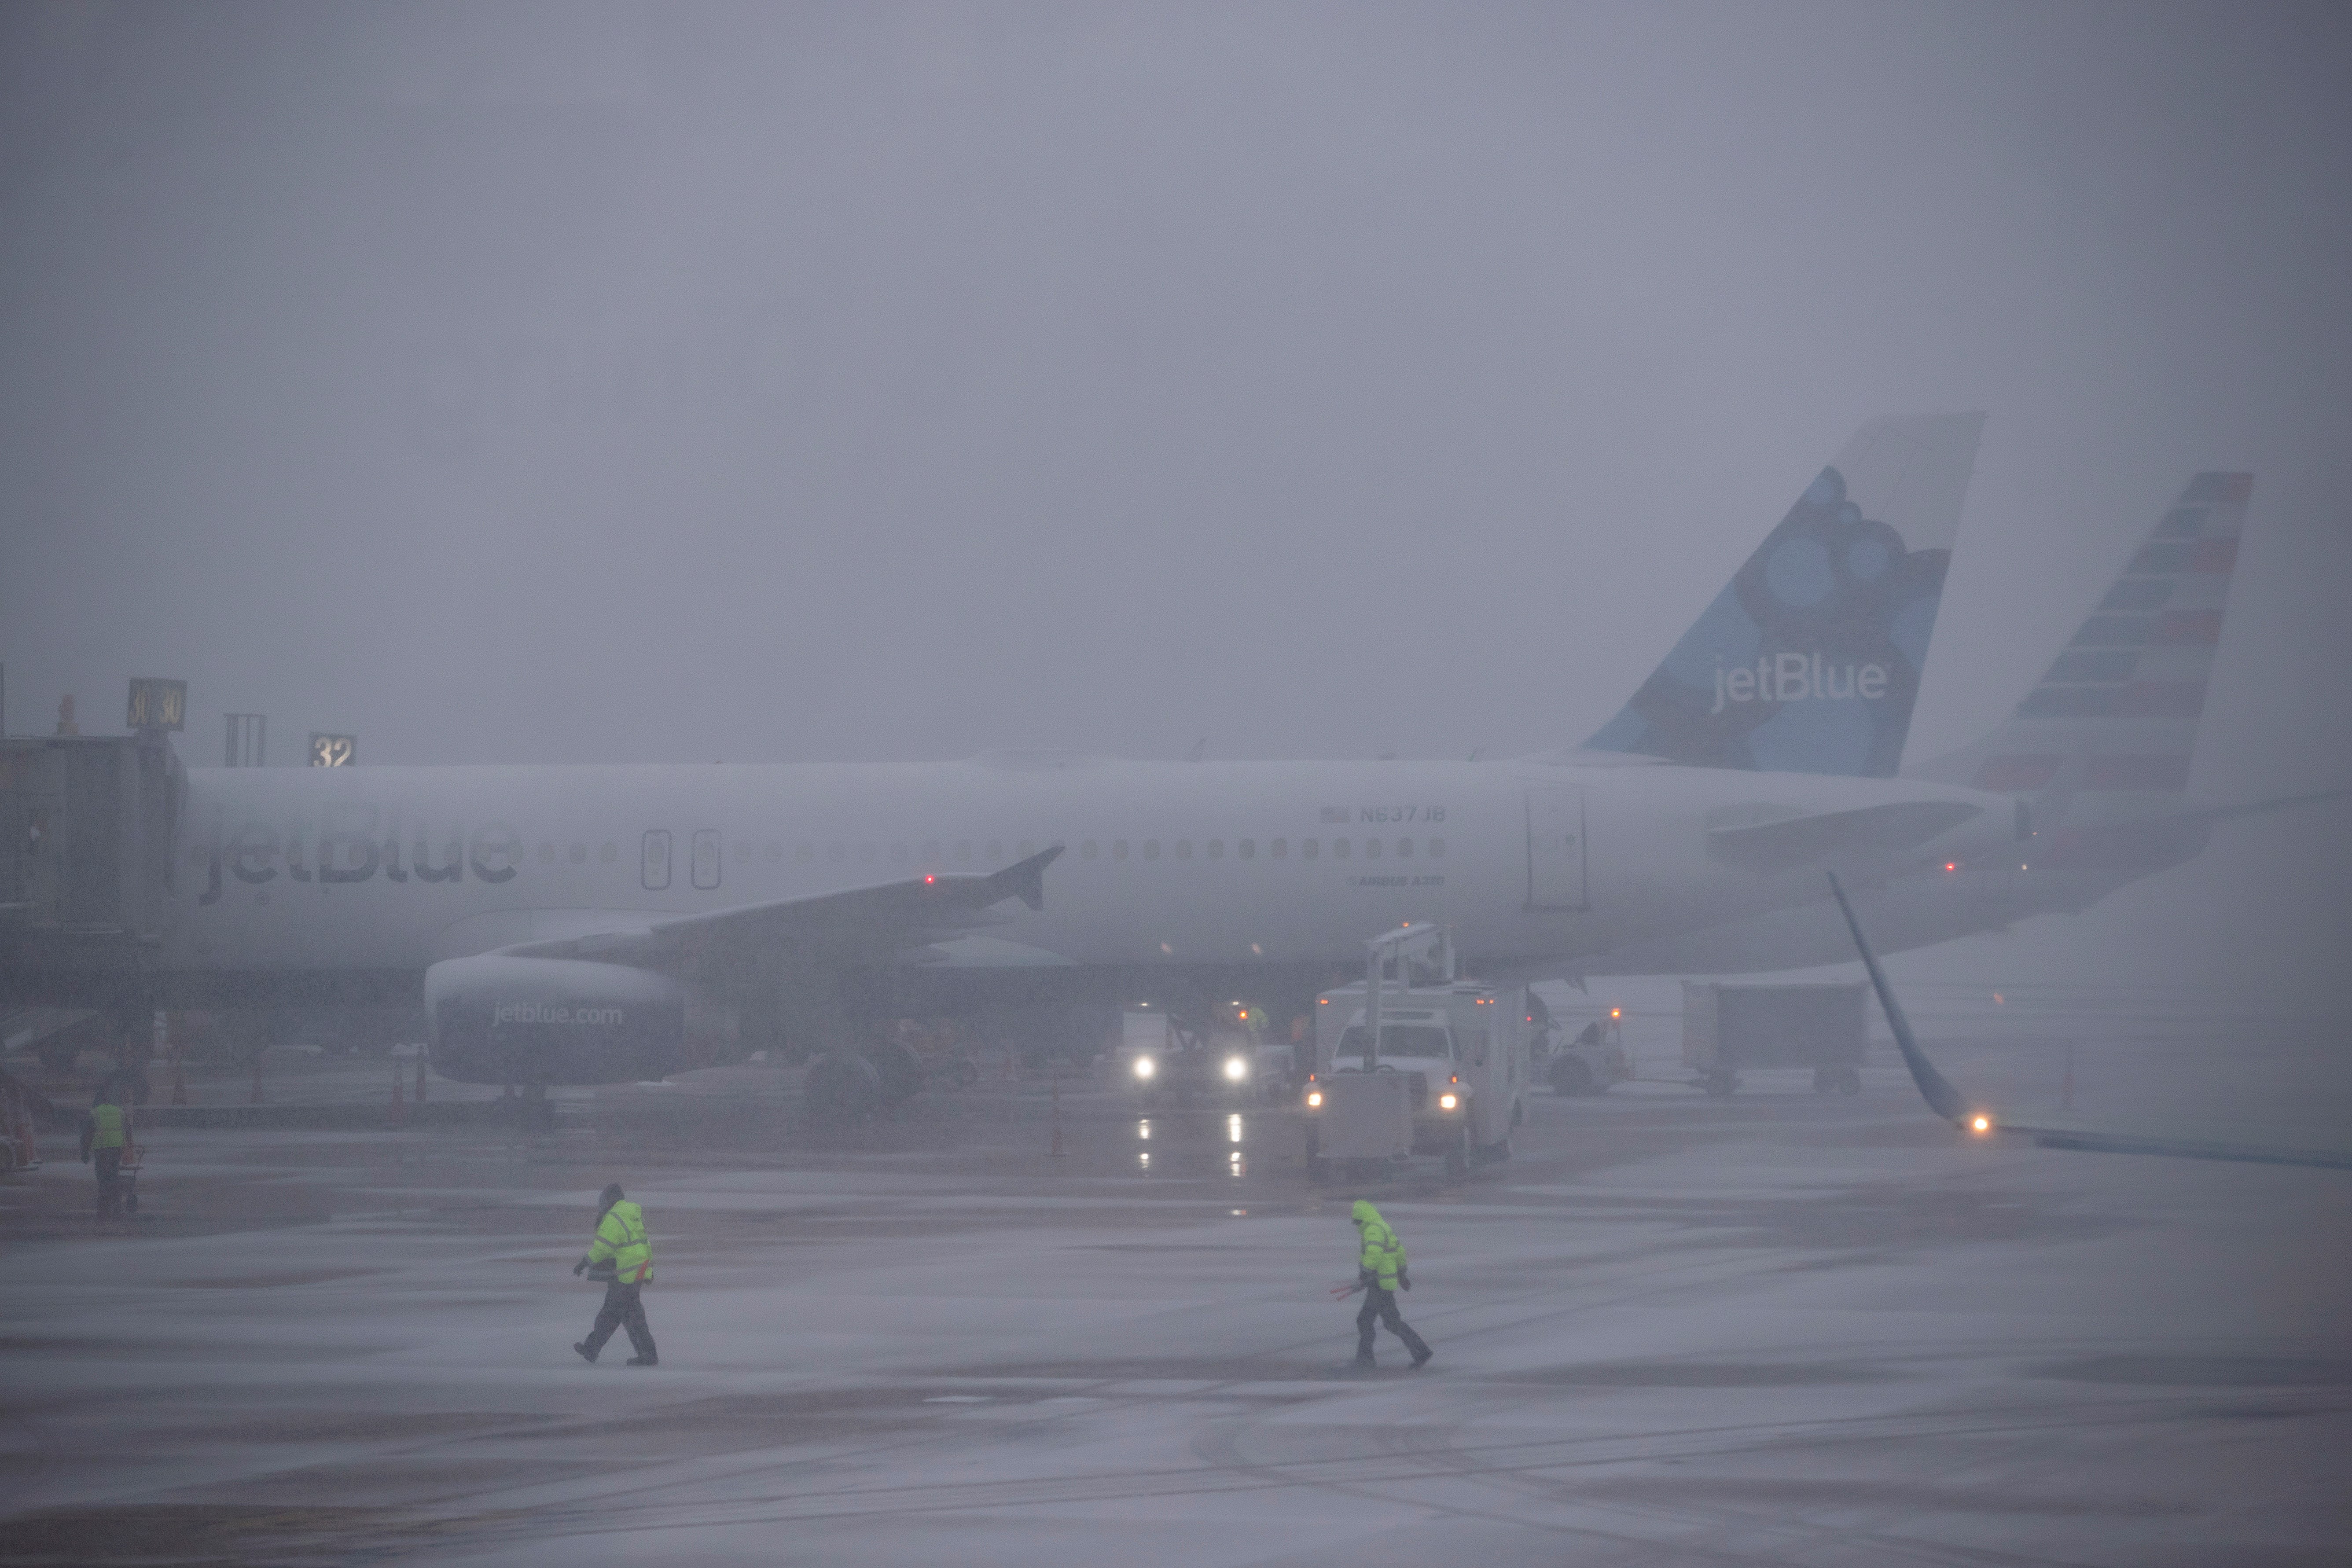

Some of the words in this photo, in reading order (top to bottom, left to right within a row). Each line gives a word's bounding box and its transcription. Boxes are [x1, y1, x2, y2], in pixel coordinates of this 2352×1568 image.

[1710, 652, 1888, 714] jetBlue
[158, 686, 181, 724] 30
[313, 737, 352, 767] 32
[1360, 805, 1446, 823] N637JB
[198, 801, 520, 906] jetBlue
[1358, 876, 1408, 886] AIRBUS
[492, 1001, 623, 1027] jetblue.com
